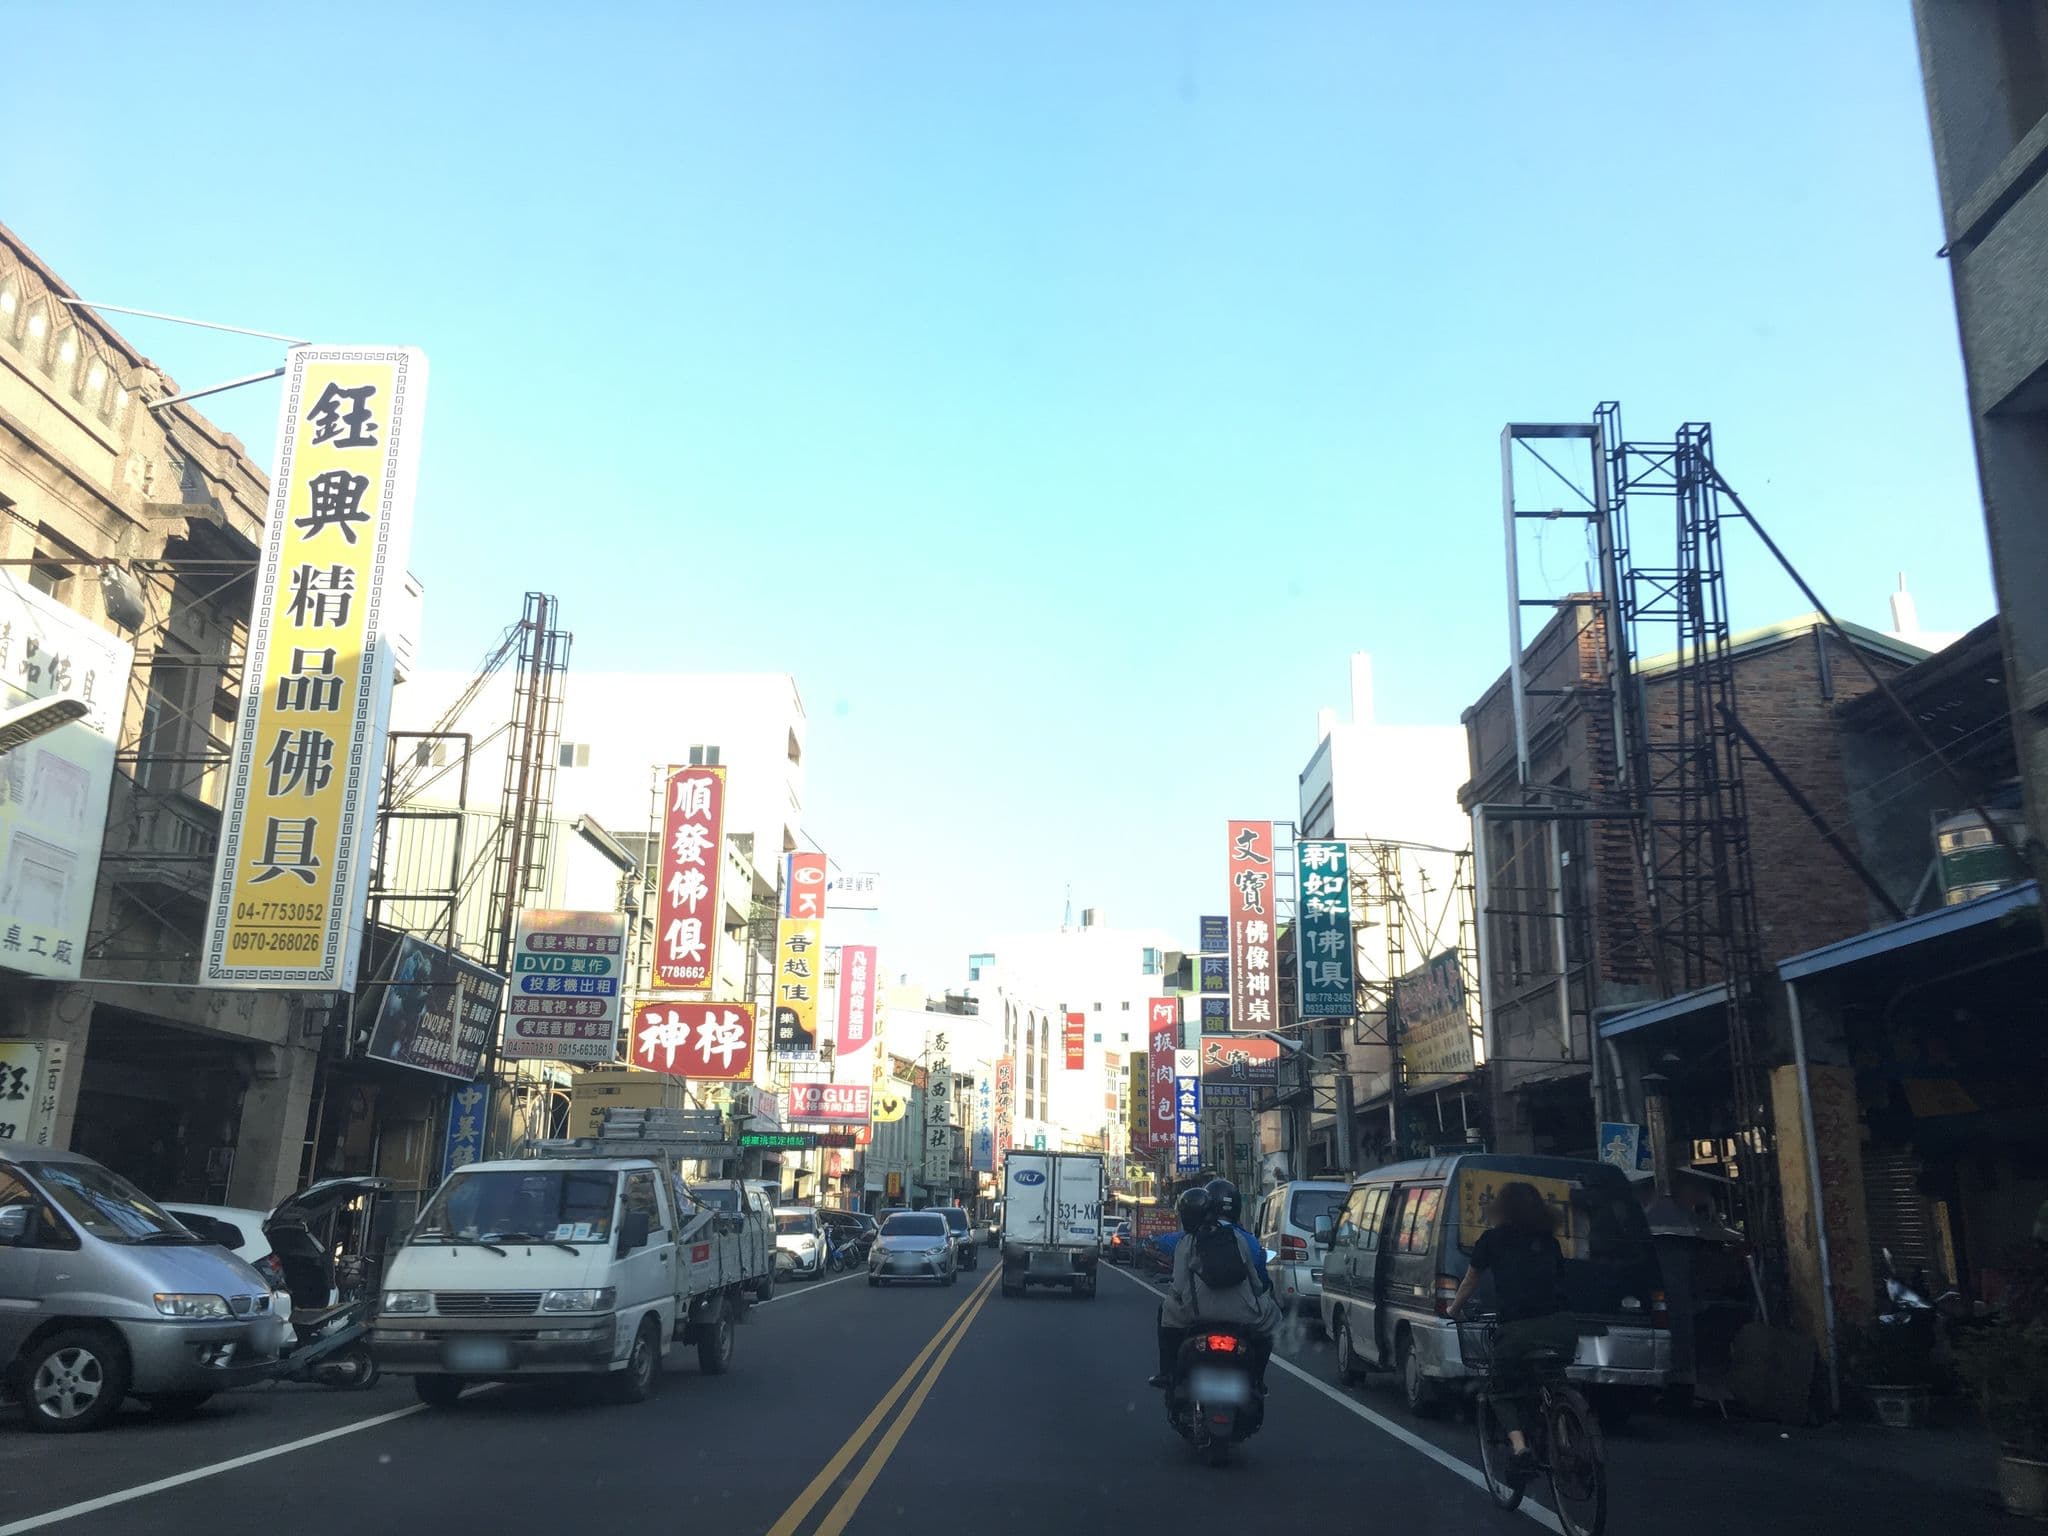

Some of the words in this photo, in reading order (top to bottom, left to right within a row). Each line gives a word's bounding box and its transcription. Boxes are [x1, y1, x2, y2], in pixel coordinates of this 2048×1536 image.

[248, 382, 379, 885] 鈺興精品佛具
[664, 778, 715, 962] 順發佛俱
[1232, 827, 1270, 915] 文寶
[236, 902, 324, 922] 04-7753052
[232, 932, 320, 952] 0970-268026
[523, 956, 566, 971] DVD
[571, 958, 603, 973] 製作
[661, 966, 705, 979] 7788662
[782, 934, 812, 1001] 音越佳
[1245, 920, 1272, 1023] 佛像神桌
[530, 977, 611, 993] 投影機出租
[780, 1012, 795, 1039] 樂器
[1153, 1003, 1176, 1120] 阿振肉包
[792, 1087, 868, 1102] VOGUE
[1018, 1174, 1039, 1182] HCT
